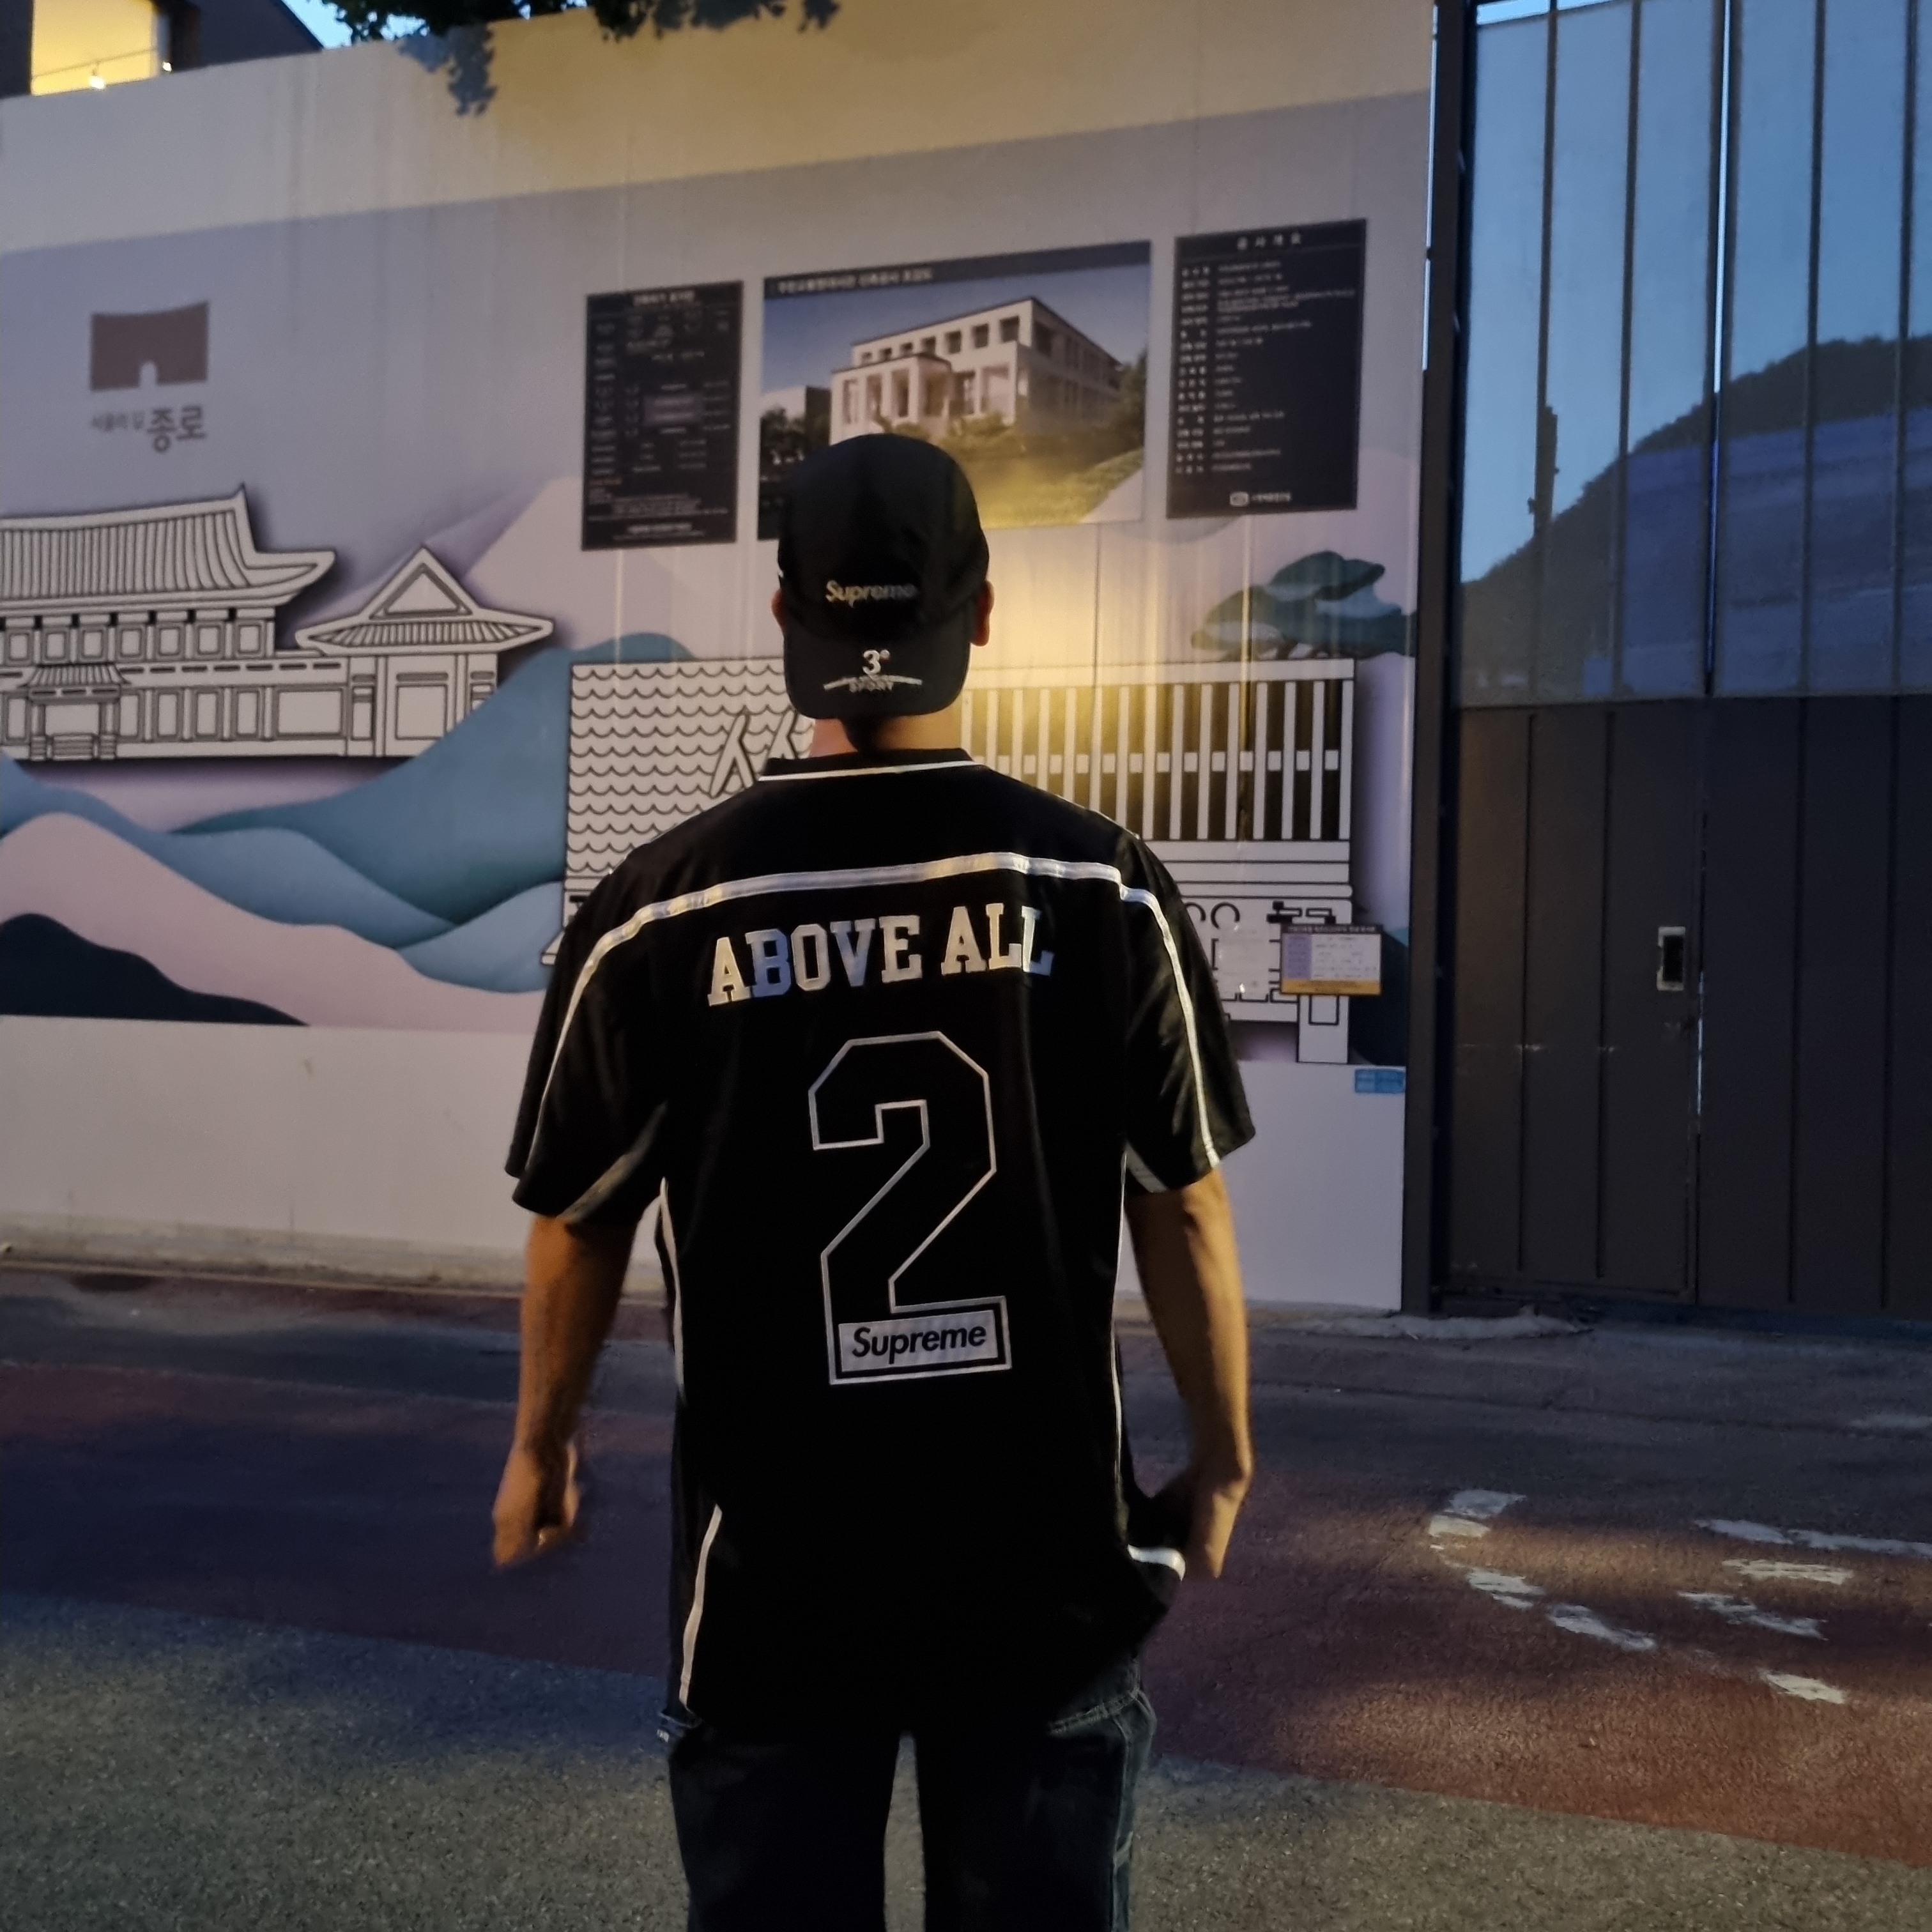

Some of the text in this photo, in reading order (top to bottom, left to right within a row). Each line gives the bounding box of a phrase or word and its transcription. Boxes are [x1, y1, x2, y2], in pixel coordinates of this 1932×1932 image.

[147, 404, 208, 454] 종로
[825, 579, 919, 607] Supreme
[707, 902, 1054, 1006] ABOVE ALL
[808, 1030, 1012, 1385] 2
[851, 1324, 987, 1365] Supreme
